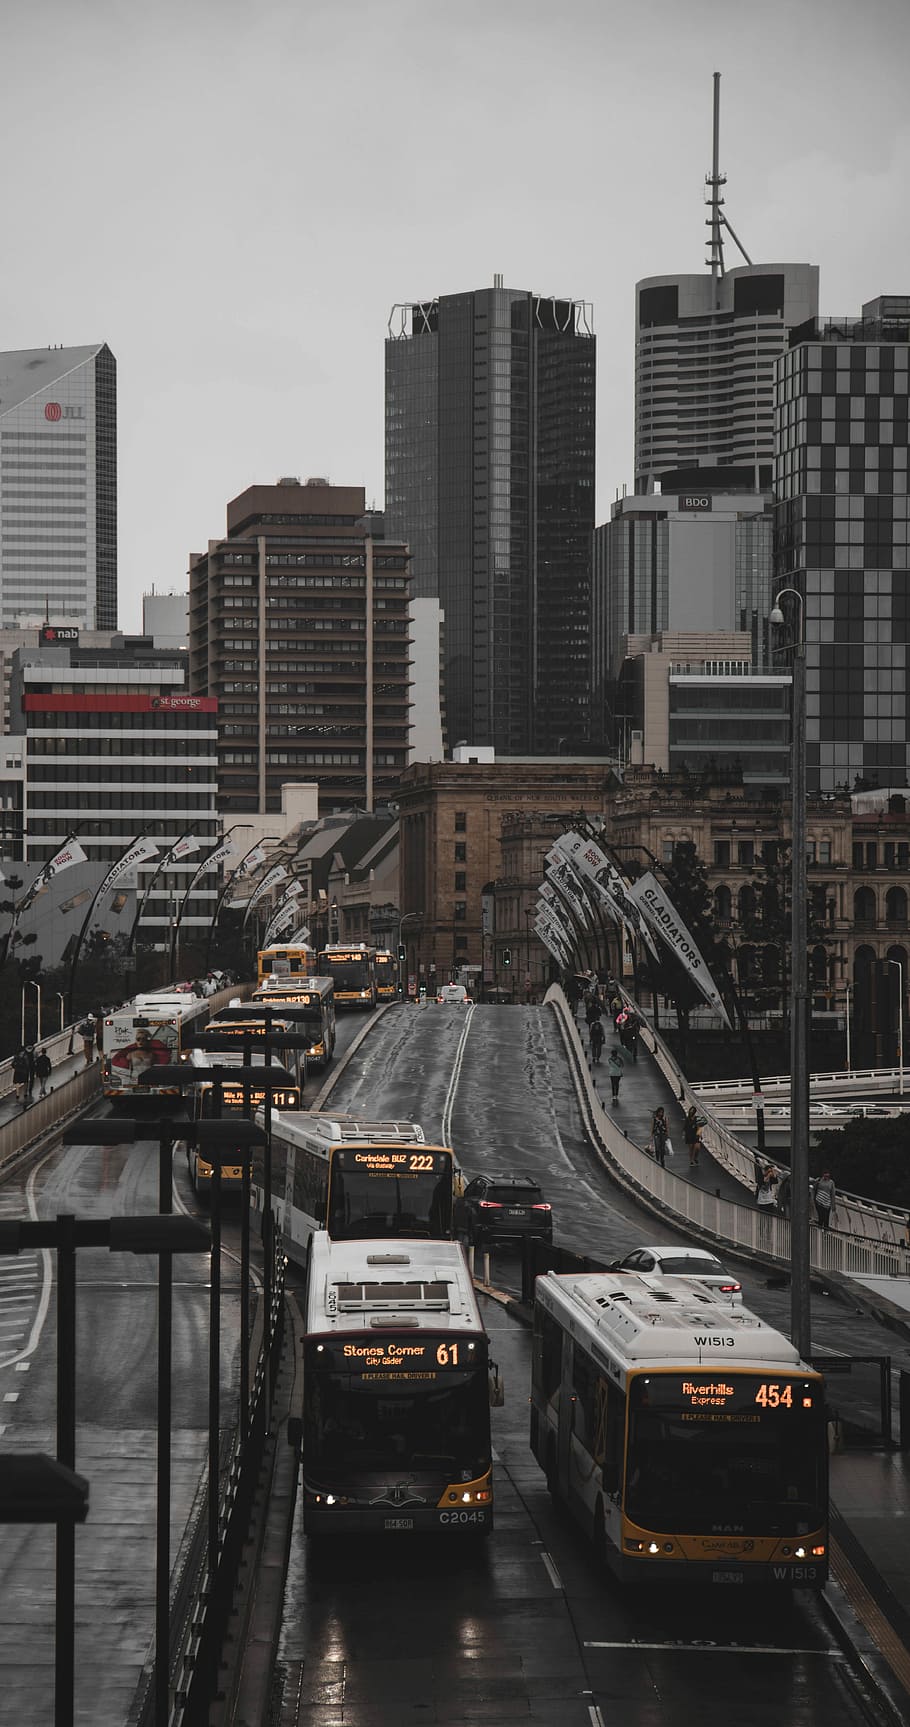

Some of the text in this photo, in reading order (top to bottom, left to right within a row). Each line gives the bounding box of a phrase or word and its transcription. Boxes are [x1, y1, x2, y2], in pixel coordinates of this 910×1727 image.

[685, 498, 709, 507] BDO
[57, 629, 78, 639] nab
[100, 847, 147, 894] GLADIATORS
[644, 889, 701, 969] GLADIATORS
[355, 1153, 433, 1170] Carindale BUZ 222
[694, 1336, 735, 1347] W1513
[343, 1343, 459, 1366] Stones Corner 61
[366, 1357, 380, 1366] City
[682, 1382, 793, 1408] Riverhills 454
[691, 1396, 726, 1406] Express
[439, 1511, 485, 1524] C2045
